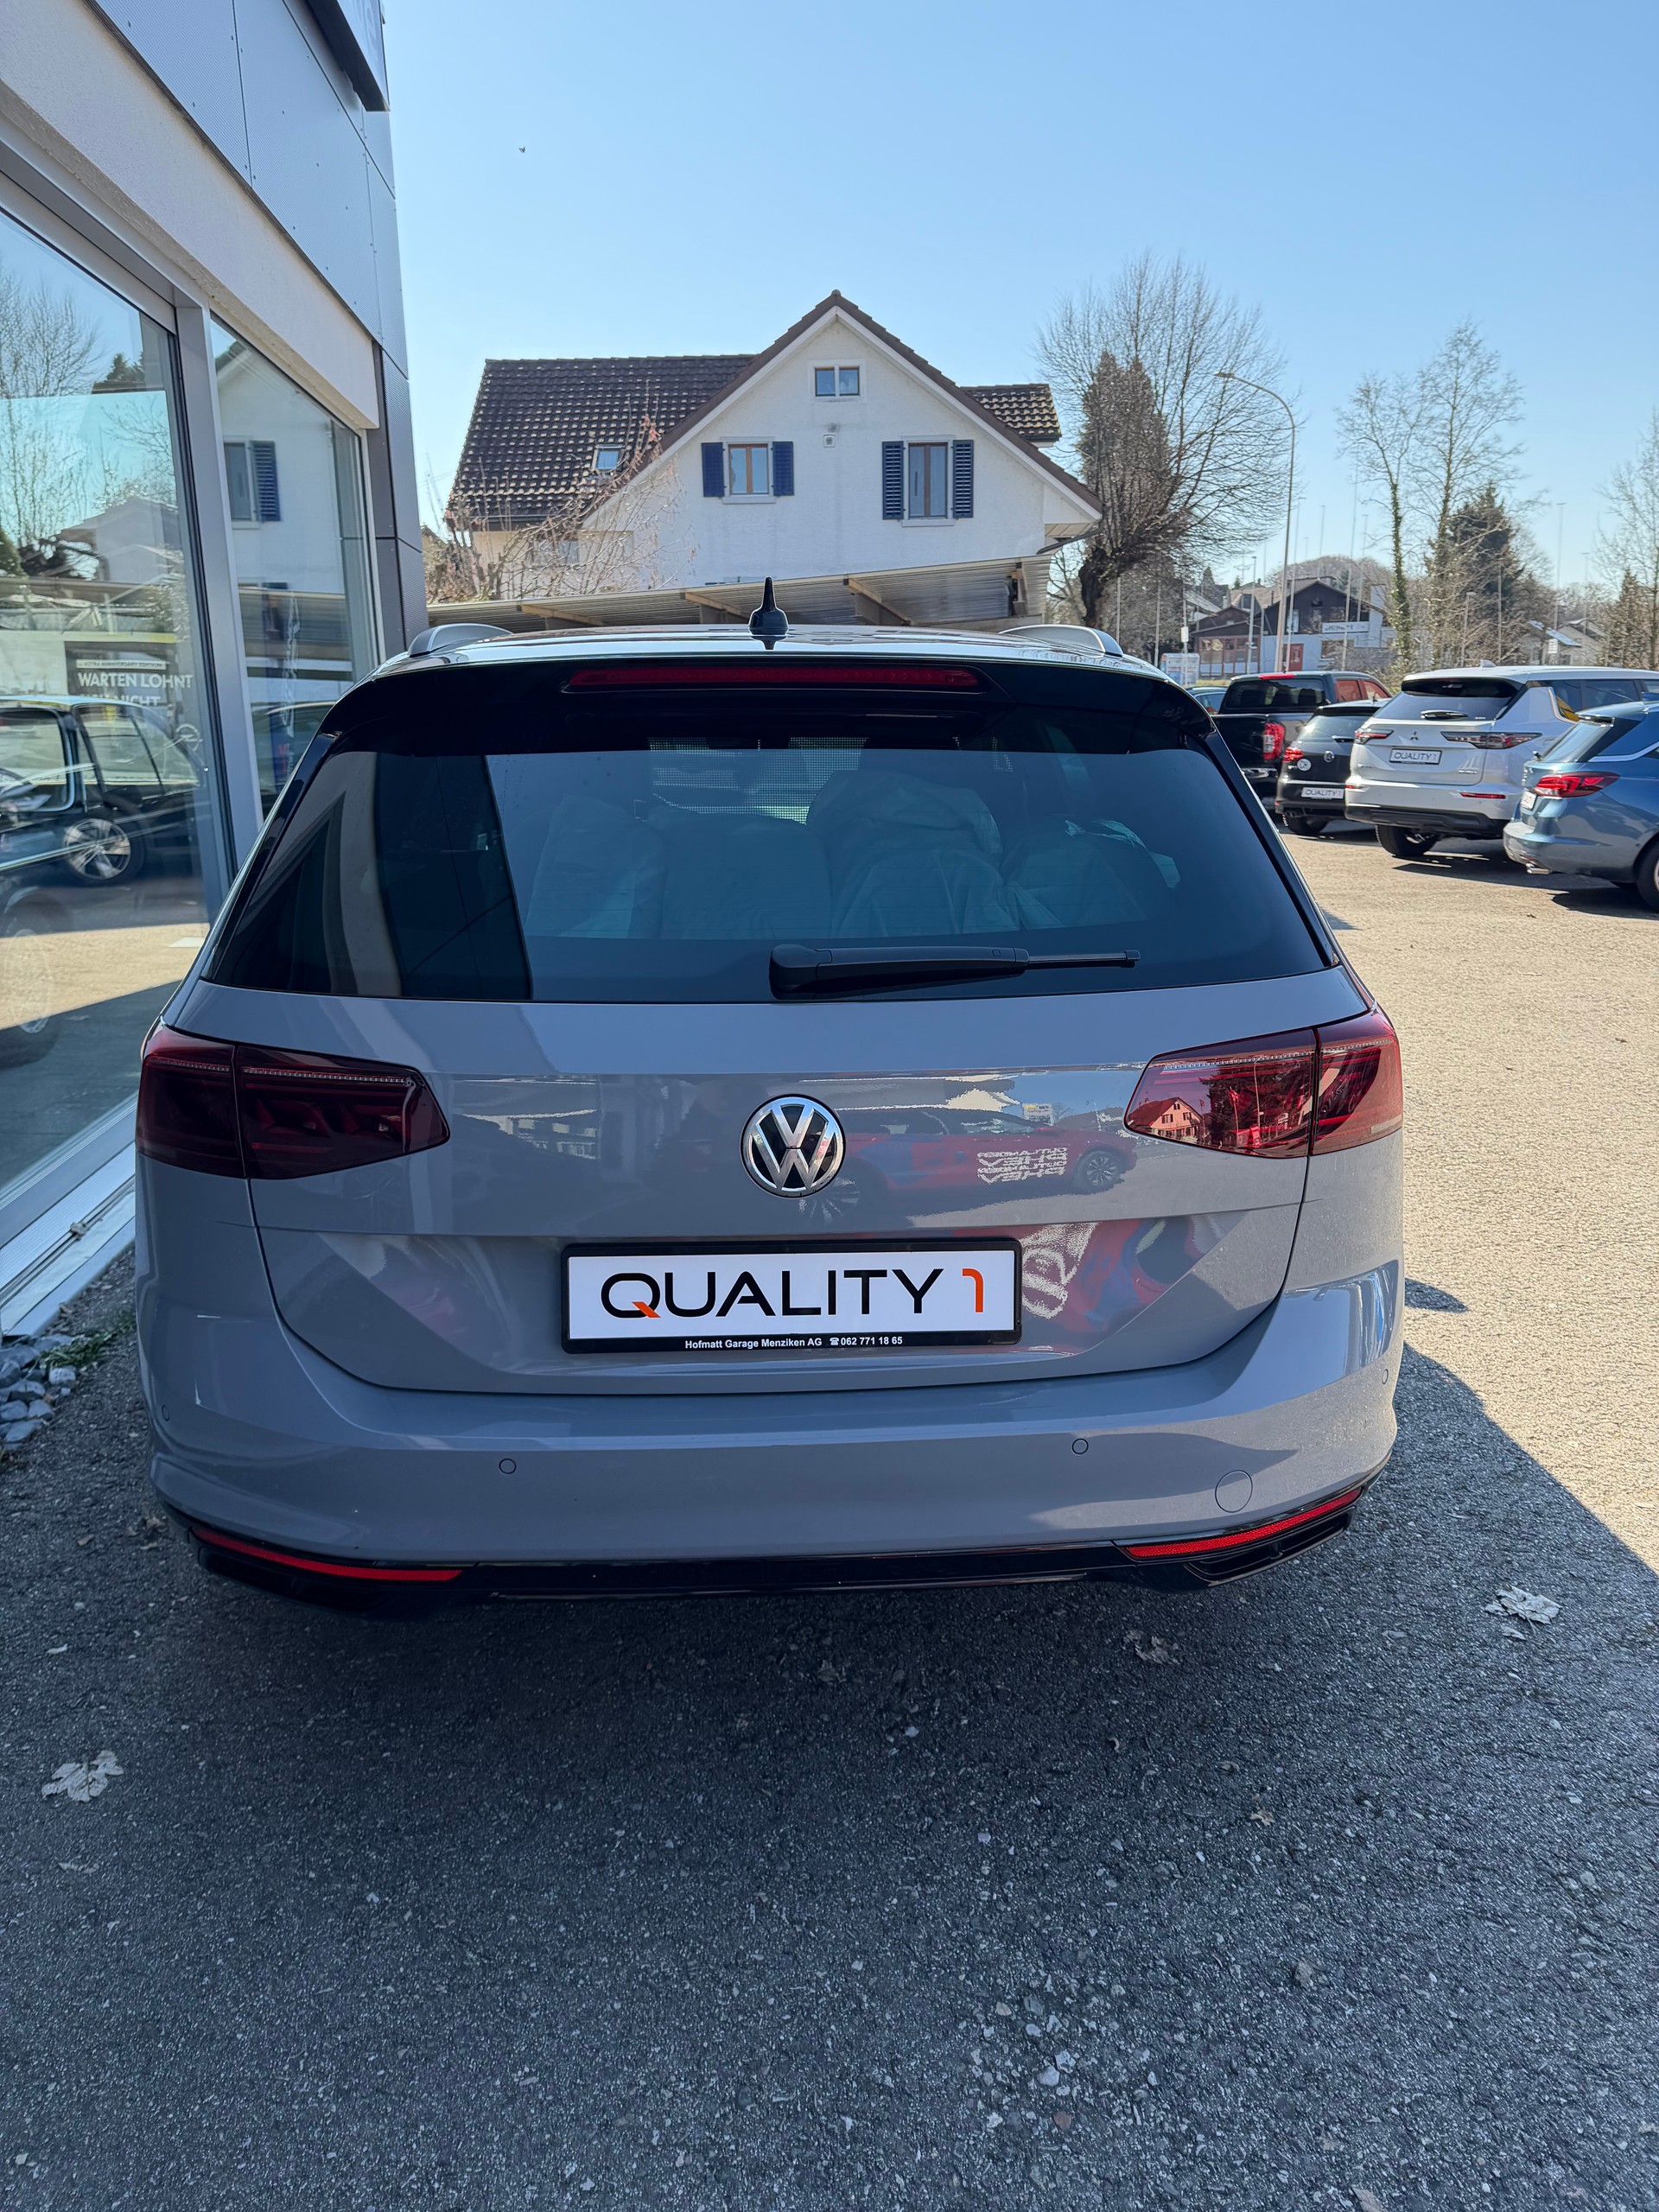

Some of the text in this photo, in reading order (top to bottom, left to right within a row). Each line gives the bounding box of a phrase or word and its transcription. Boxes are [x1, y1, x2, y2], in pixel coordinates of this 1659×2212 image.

[78, 671, 137, 688] WARTEN
[1394, 752, 1432, 760] QUALITY
[1305, 788, 1337, 797] QUALITY
[742, 1095, 845, 1198] VW
[600, 1268, 944, 1319] QUALITY
[962, 1268, 984, 1314] 1
[685, 1336, 903, 1350] Hofmatt Garage Menziken AG 062 771 18 65
